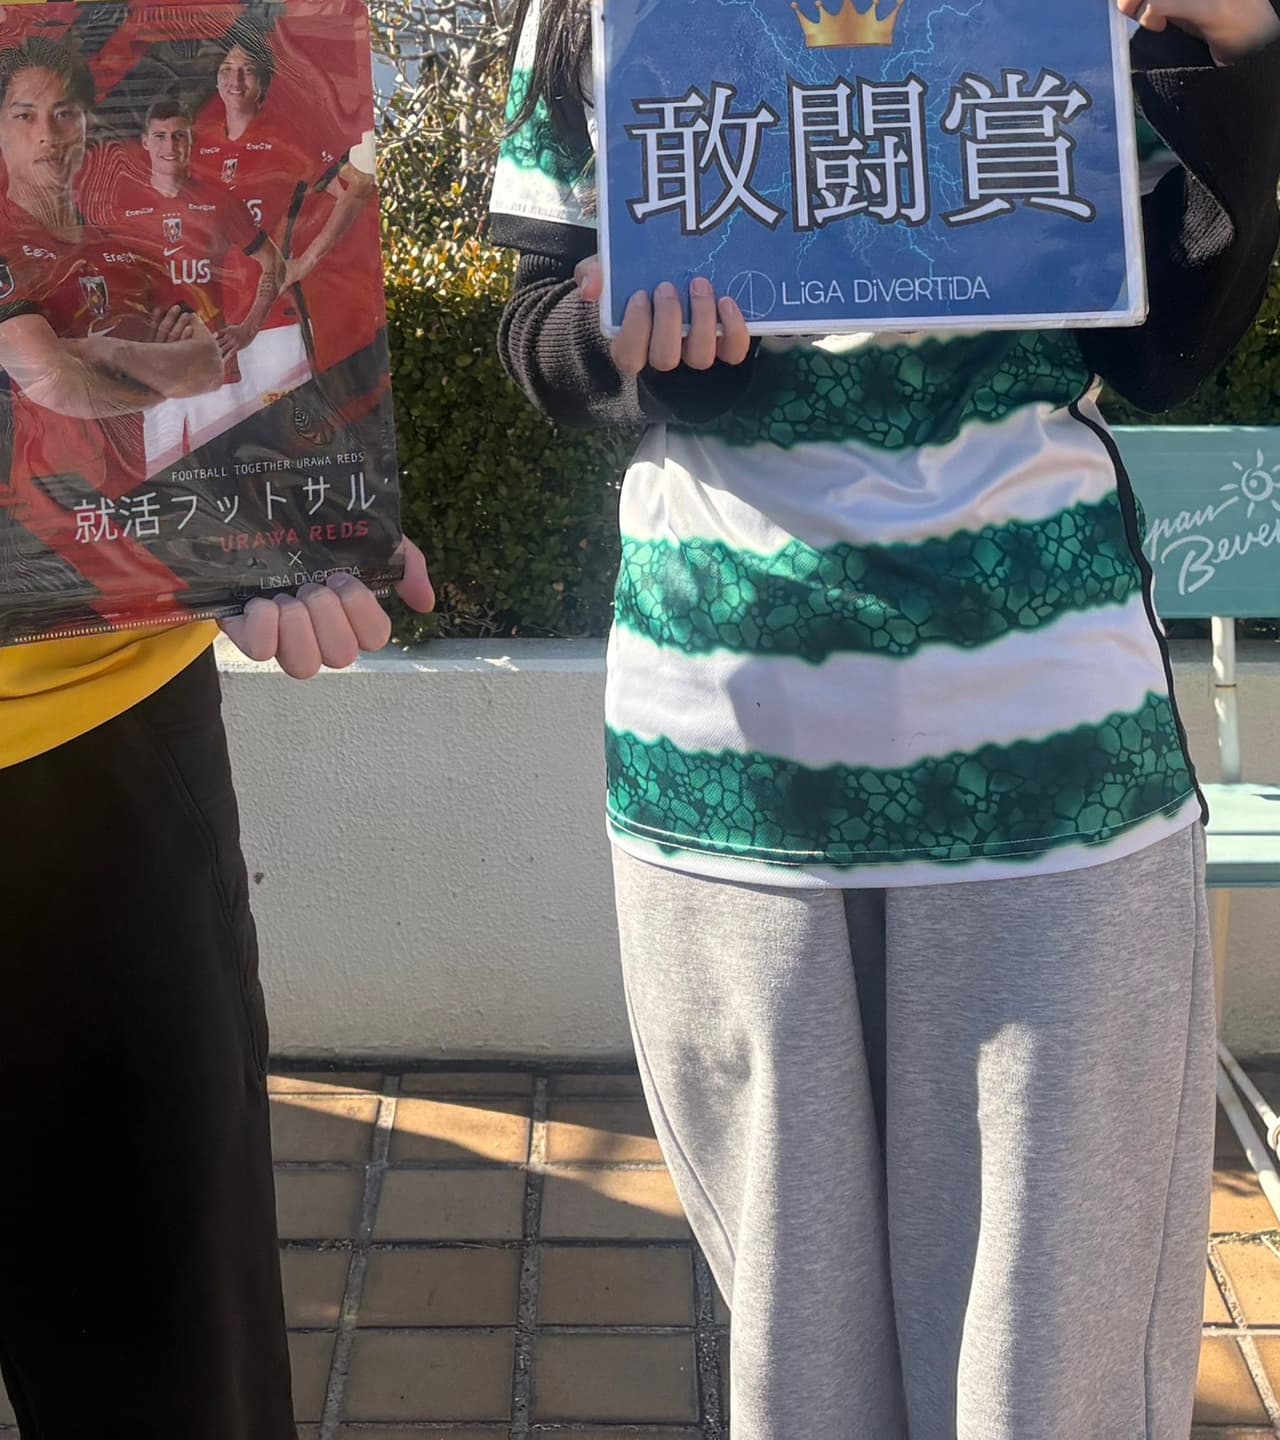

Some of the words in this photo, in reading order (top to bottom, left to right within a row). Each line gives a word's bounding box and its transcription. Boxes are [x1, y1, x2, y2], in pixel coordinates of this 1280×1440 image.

[626, 70, 1095, 234] 敢闘賞
[172, 468, 227, 482] FOOTBALL
[234, 460, 291, 475] TOGETHER
[297, 455, 331, 469] URAWA
[337, 451, 365, 464] REDS
[73, 471, 376, 544] 就活フットサル
[221, 527, 300, 552] URAWA
[310, 520, 369, 542] REDS
